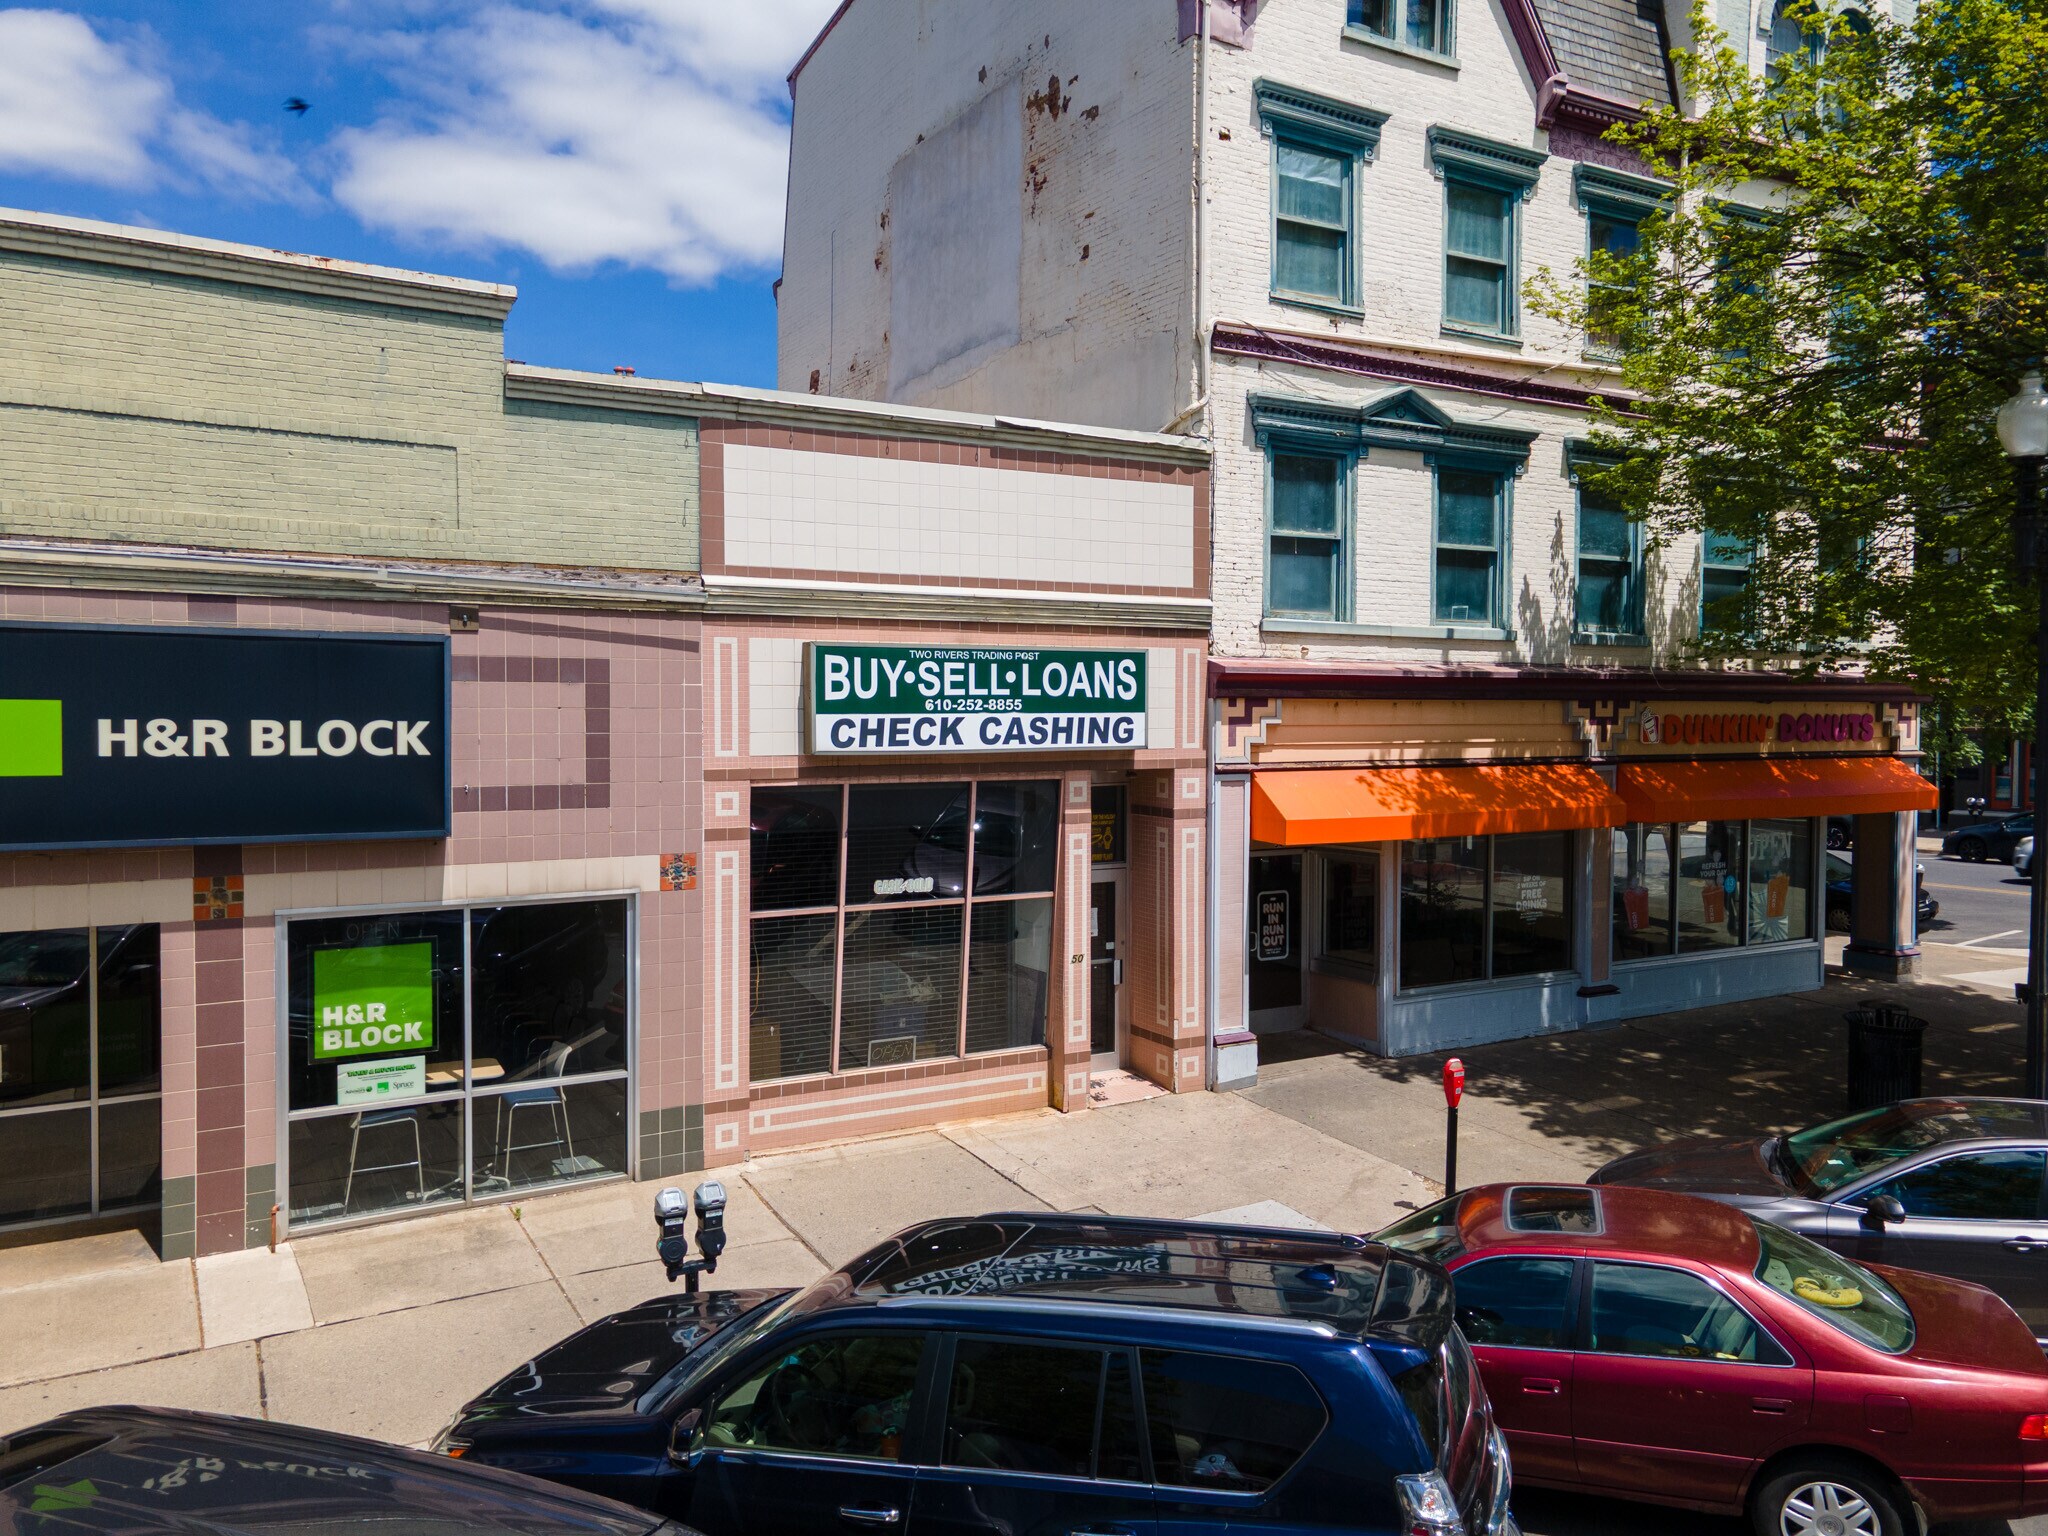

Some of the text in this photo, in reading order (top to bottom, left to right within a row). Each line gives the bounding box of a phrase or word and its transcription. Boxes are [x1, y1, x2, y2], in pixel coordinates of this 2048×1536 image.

[908, 650, 1040, 661] TWO RIVERS TRADING POST
[925, 698, 1023, 711] 610-252-8855
[830, 716, 1135, 749] CHECK CASHING
[1779, 713, 1874, 743] DONUTS
[97, 718, 431, 758] H&R BLOCK
[1702, 862, 1726, 870] REFRESH
[1700, 869, 1716, 878] YOUR
[1521, 889, 1543, 900] FREE
[1262, 902, 1284, 914] RUN
[1515, 898, 1548, 911] DRINKS
[1267, 913, 1279, 924] IN
[346, 921, 400, 940] OPEN
[1262, 924, 1284, 936] RUN
[1262, 935, 1285, 947] OUT
[1070, 953, 1085, 964] 50
[322, 1002, 387, 1027] H&R
[323, 1021, 423, 1051] BLOCK
[871, 1043, 912, 1060] OPEN
[392, 1080, 415, 1090] Spruce
